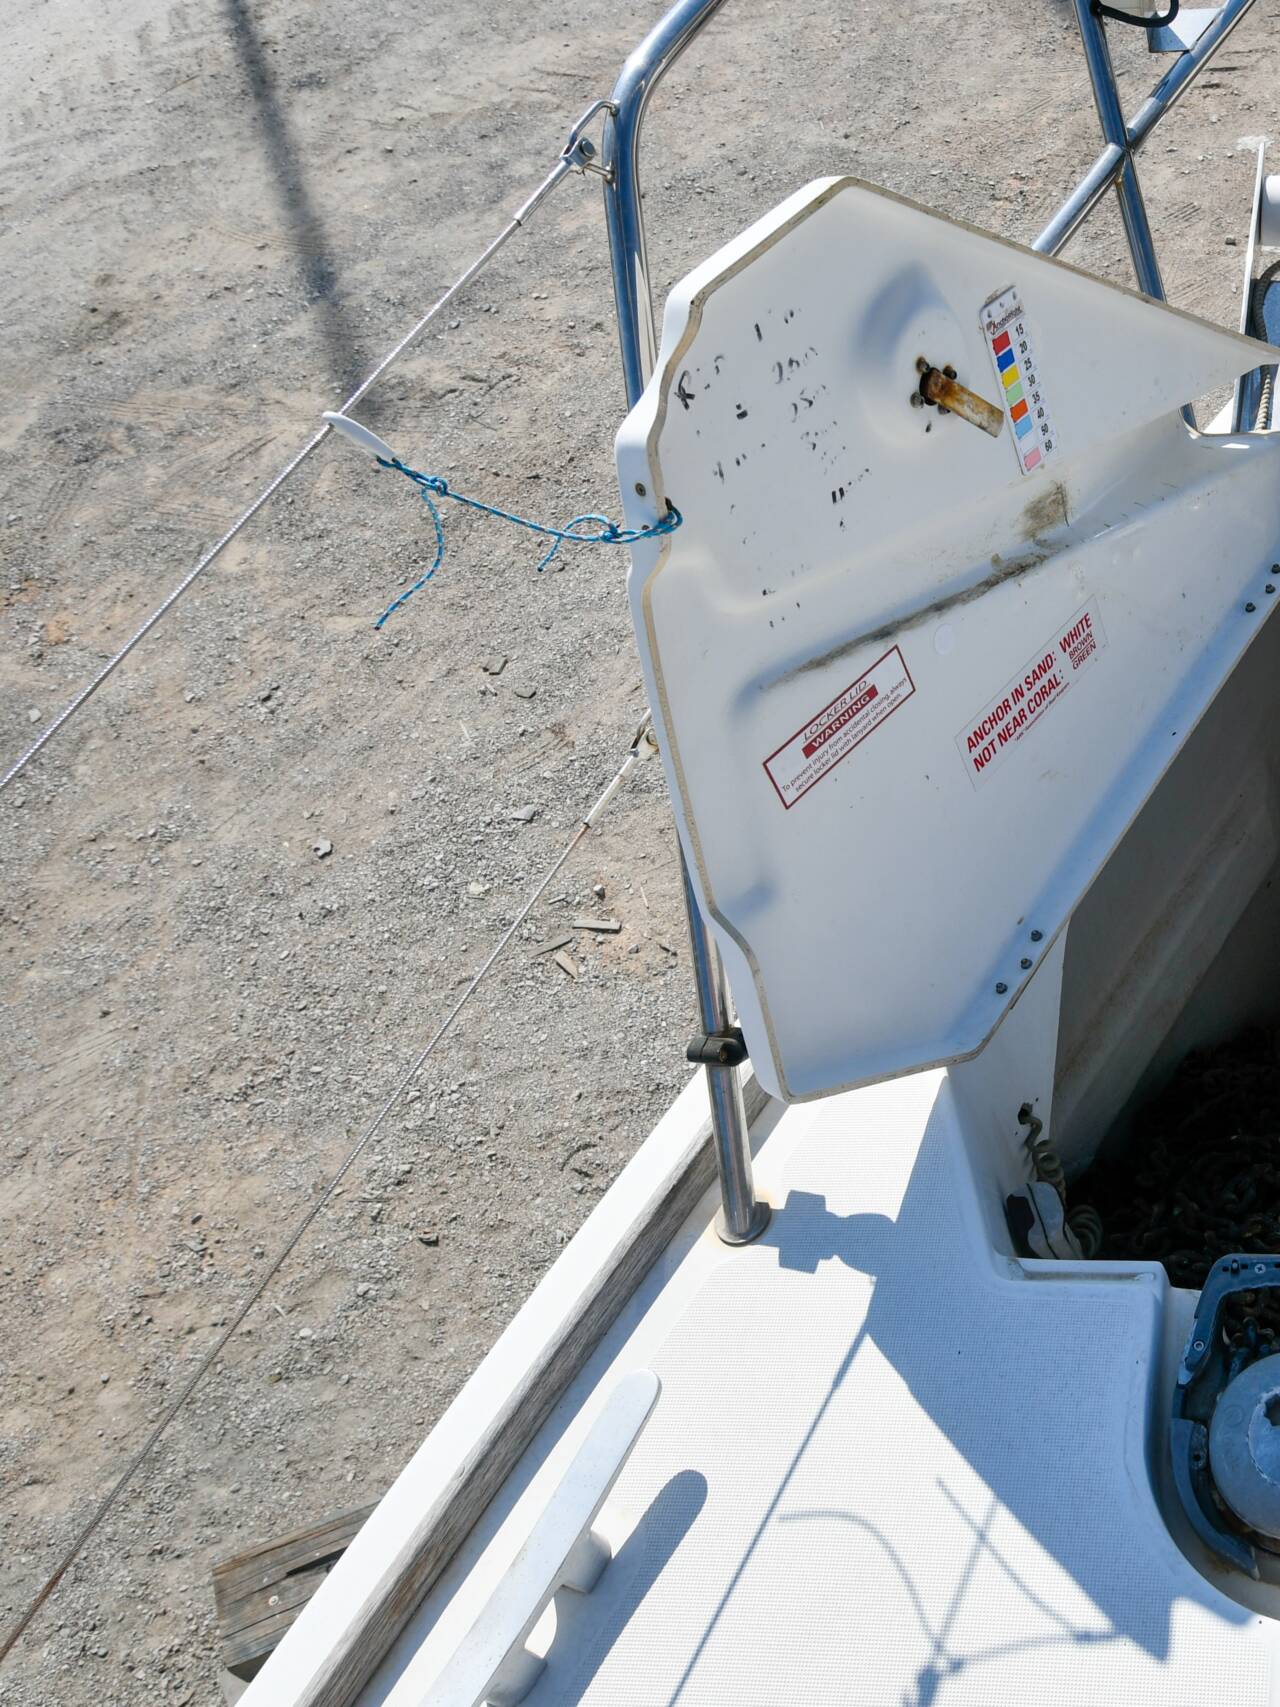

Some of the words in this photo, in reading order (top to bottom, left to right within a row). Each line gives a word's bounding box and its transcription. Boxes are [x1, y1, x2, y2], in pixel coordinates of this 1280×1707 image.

[1016, 323, 1024, 336] 15
[1019, 340, 1028, 354] 20
[1024, 357, 1032, 371] 25
[1028, 374, 1036, 387] 30
[1032, 391, 1041, 404] 35
[1037, 407, 1045, 419] 40
[1045, 439, 1053, 452] 60
[1069, 631, 1093, 660] BROWN
[1073, 641, 1097, 670] GREEN
[966, 699, 1012, 753] ANCHOR
[1011, 684, 1025, 705] IN
[1024, 651, 1057, 691] SAND:
[1059, 613, 1092, 653] WHITE
[804, 698, 848, 741] LOCKER
[849, 680, 867, 700] LID
[812, 695, 868, 747] WARNING
[973, 739, 998, 772] NOT
[997, 708, 1028, 747] NEAR
[1027, 669, 1064, 715] CORAL:
[782, 783, 790, 793] To
[789, 764, 812, 787] prevent
[811, 749, 829, 767] injury
[828, 735, 842, 750] from
[841, 711, 870, 737] accidental
[813, 758, 831, 775] locker
[830, 750, 838, 759] lid
[838, 739, 852, 752] with
[851, 720, 872, 742] lanyard
[871, 707, 887, 722] when
